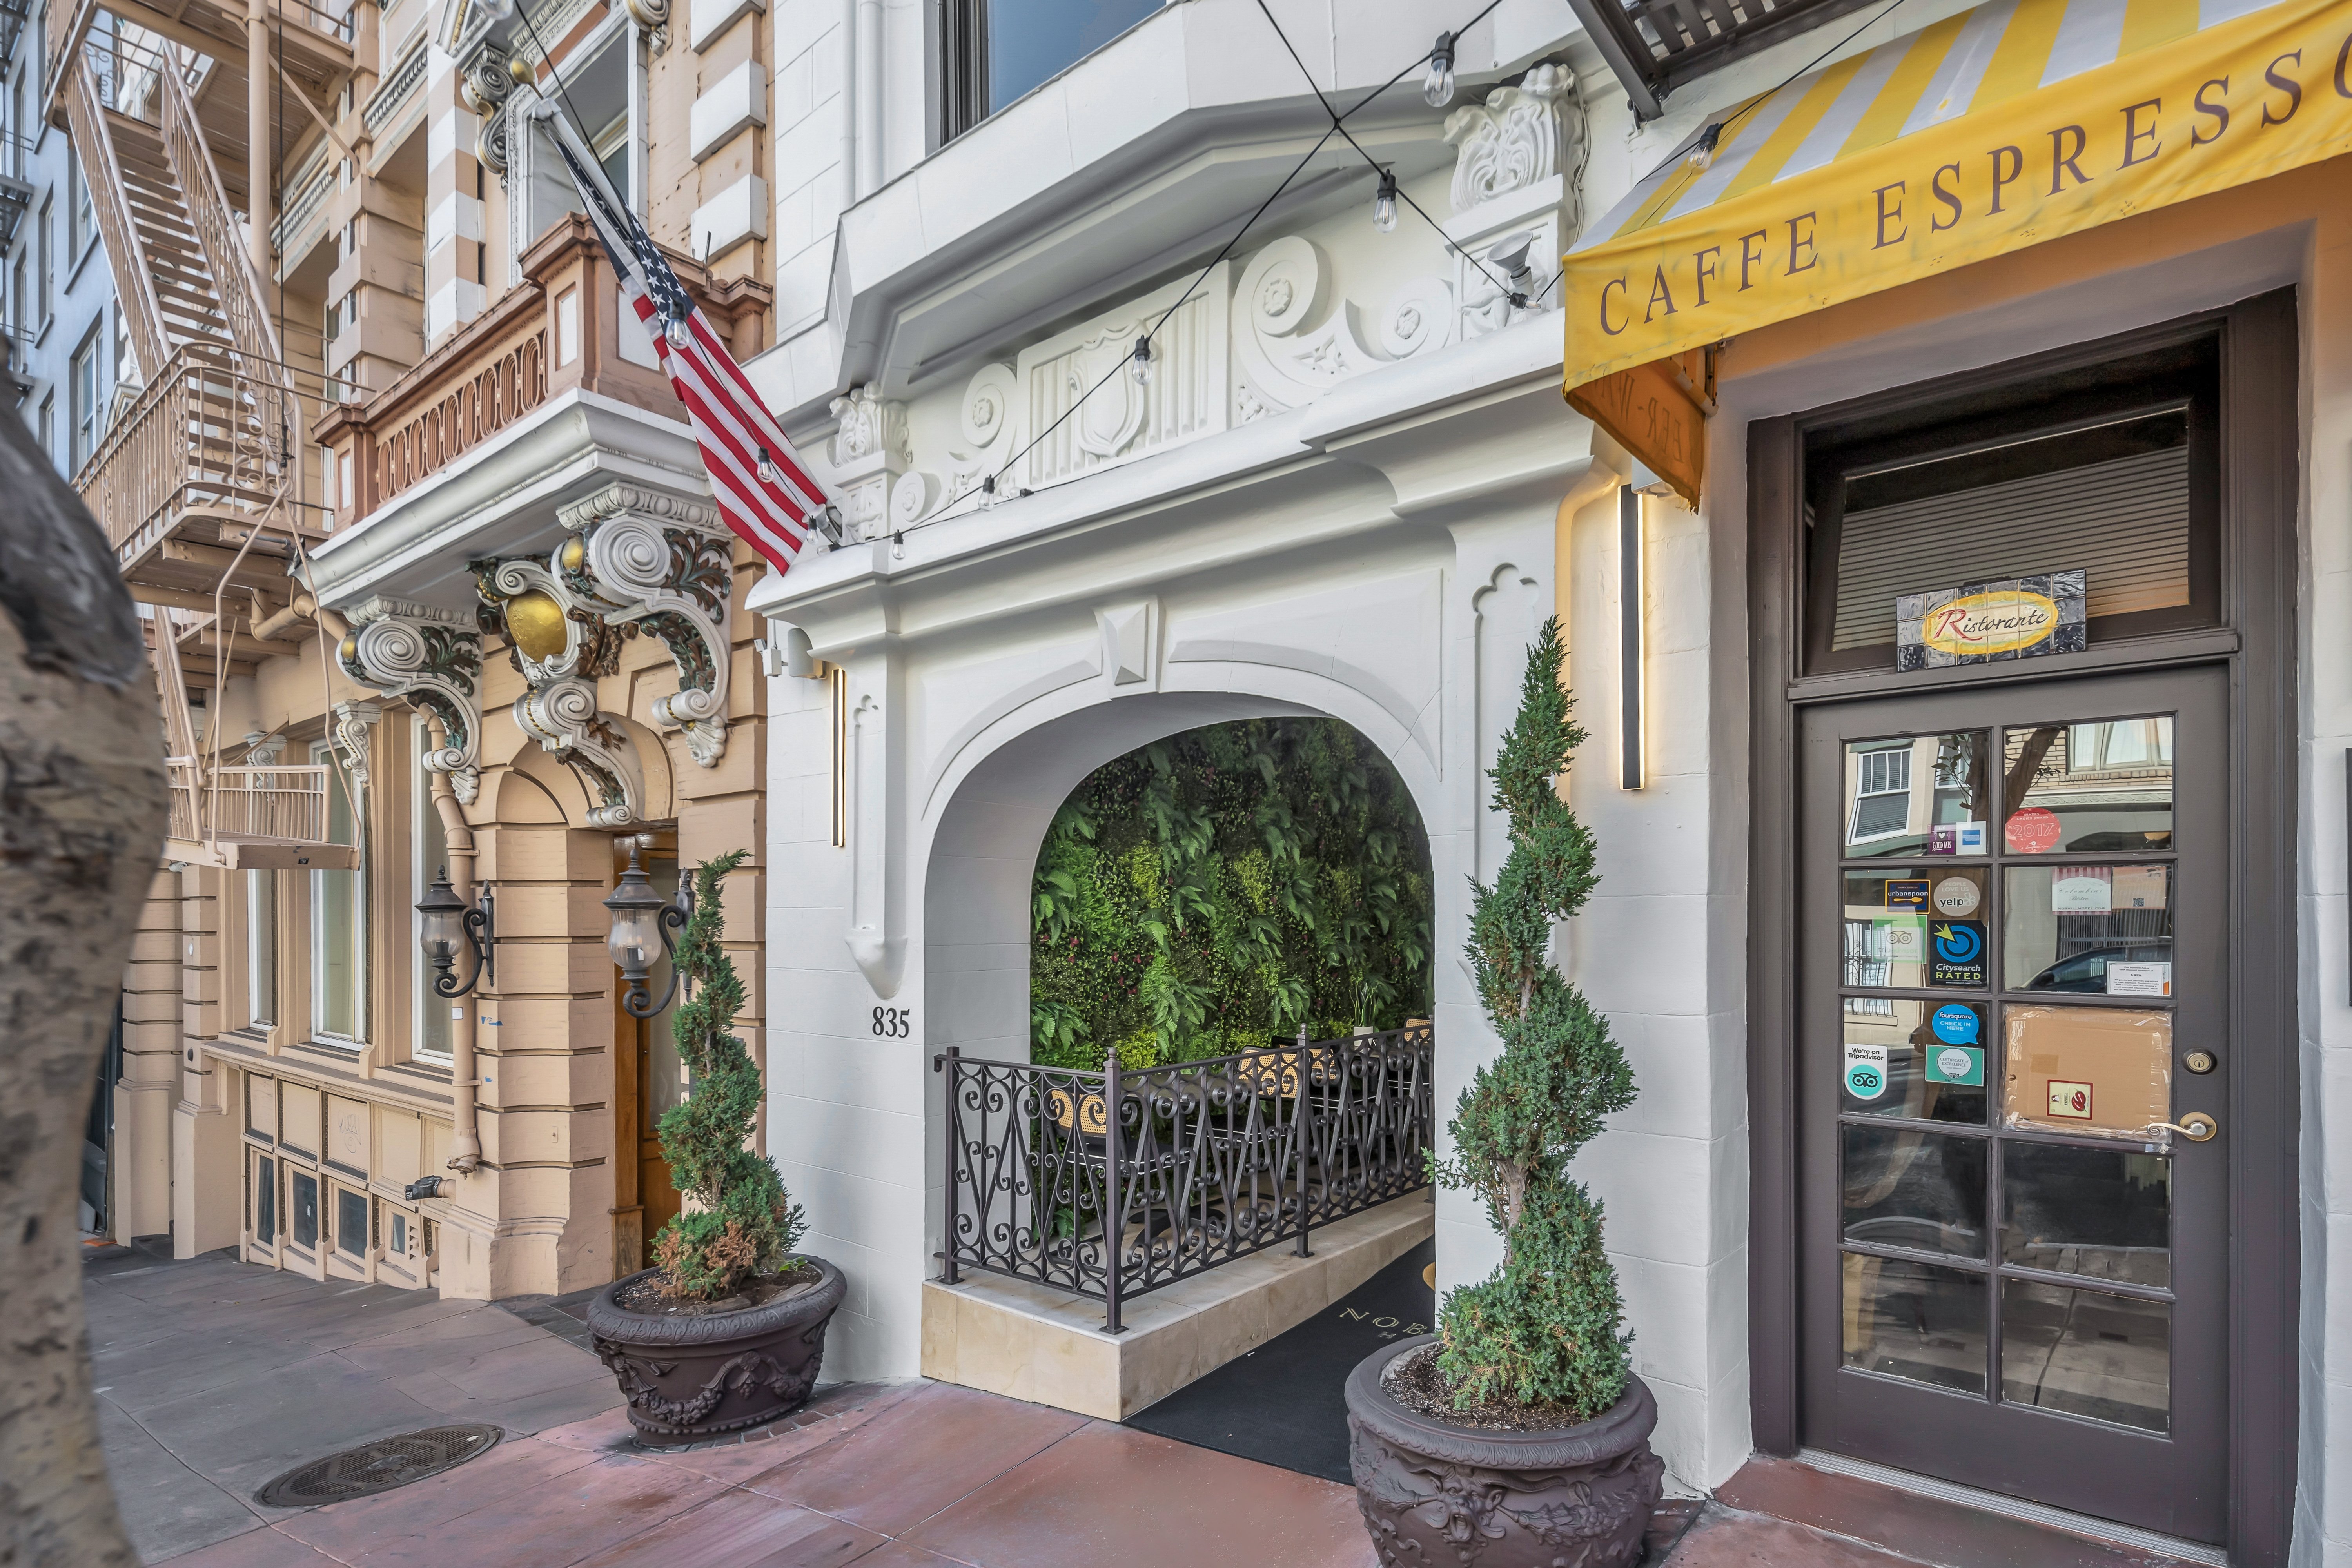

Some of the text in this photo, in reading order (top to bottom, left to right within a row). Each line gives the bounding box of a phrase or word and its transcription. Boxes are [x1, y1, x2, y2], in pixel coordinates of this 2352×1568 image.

[1599, 211, 1820, 336] CAFFE
[1933, 609, 2049, 641] Ristorante
[2013, 823, 2054, 837] 2017
[1932, 841, 1943, 851] GOOD
[1940, 897, 1963, 907] yelp
[1936, 964, 1980, 972] Citysearch
[872, 1006, 910, 1038] 835
[1939, 1012, 1972, 1020] foursquare
[1338, 1307, 1428, 1334] NOB
